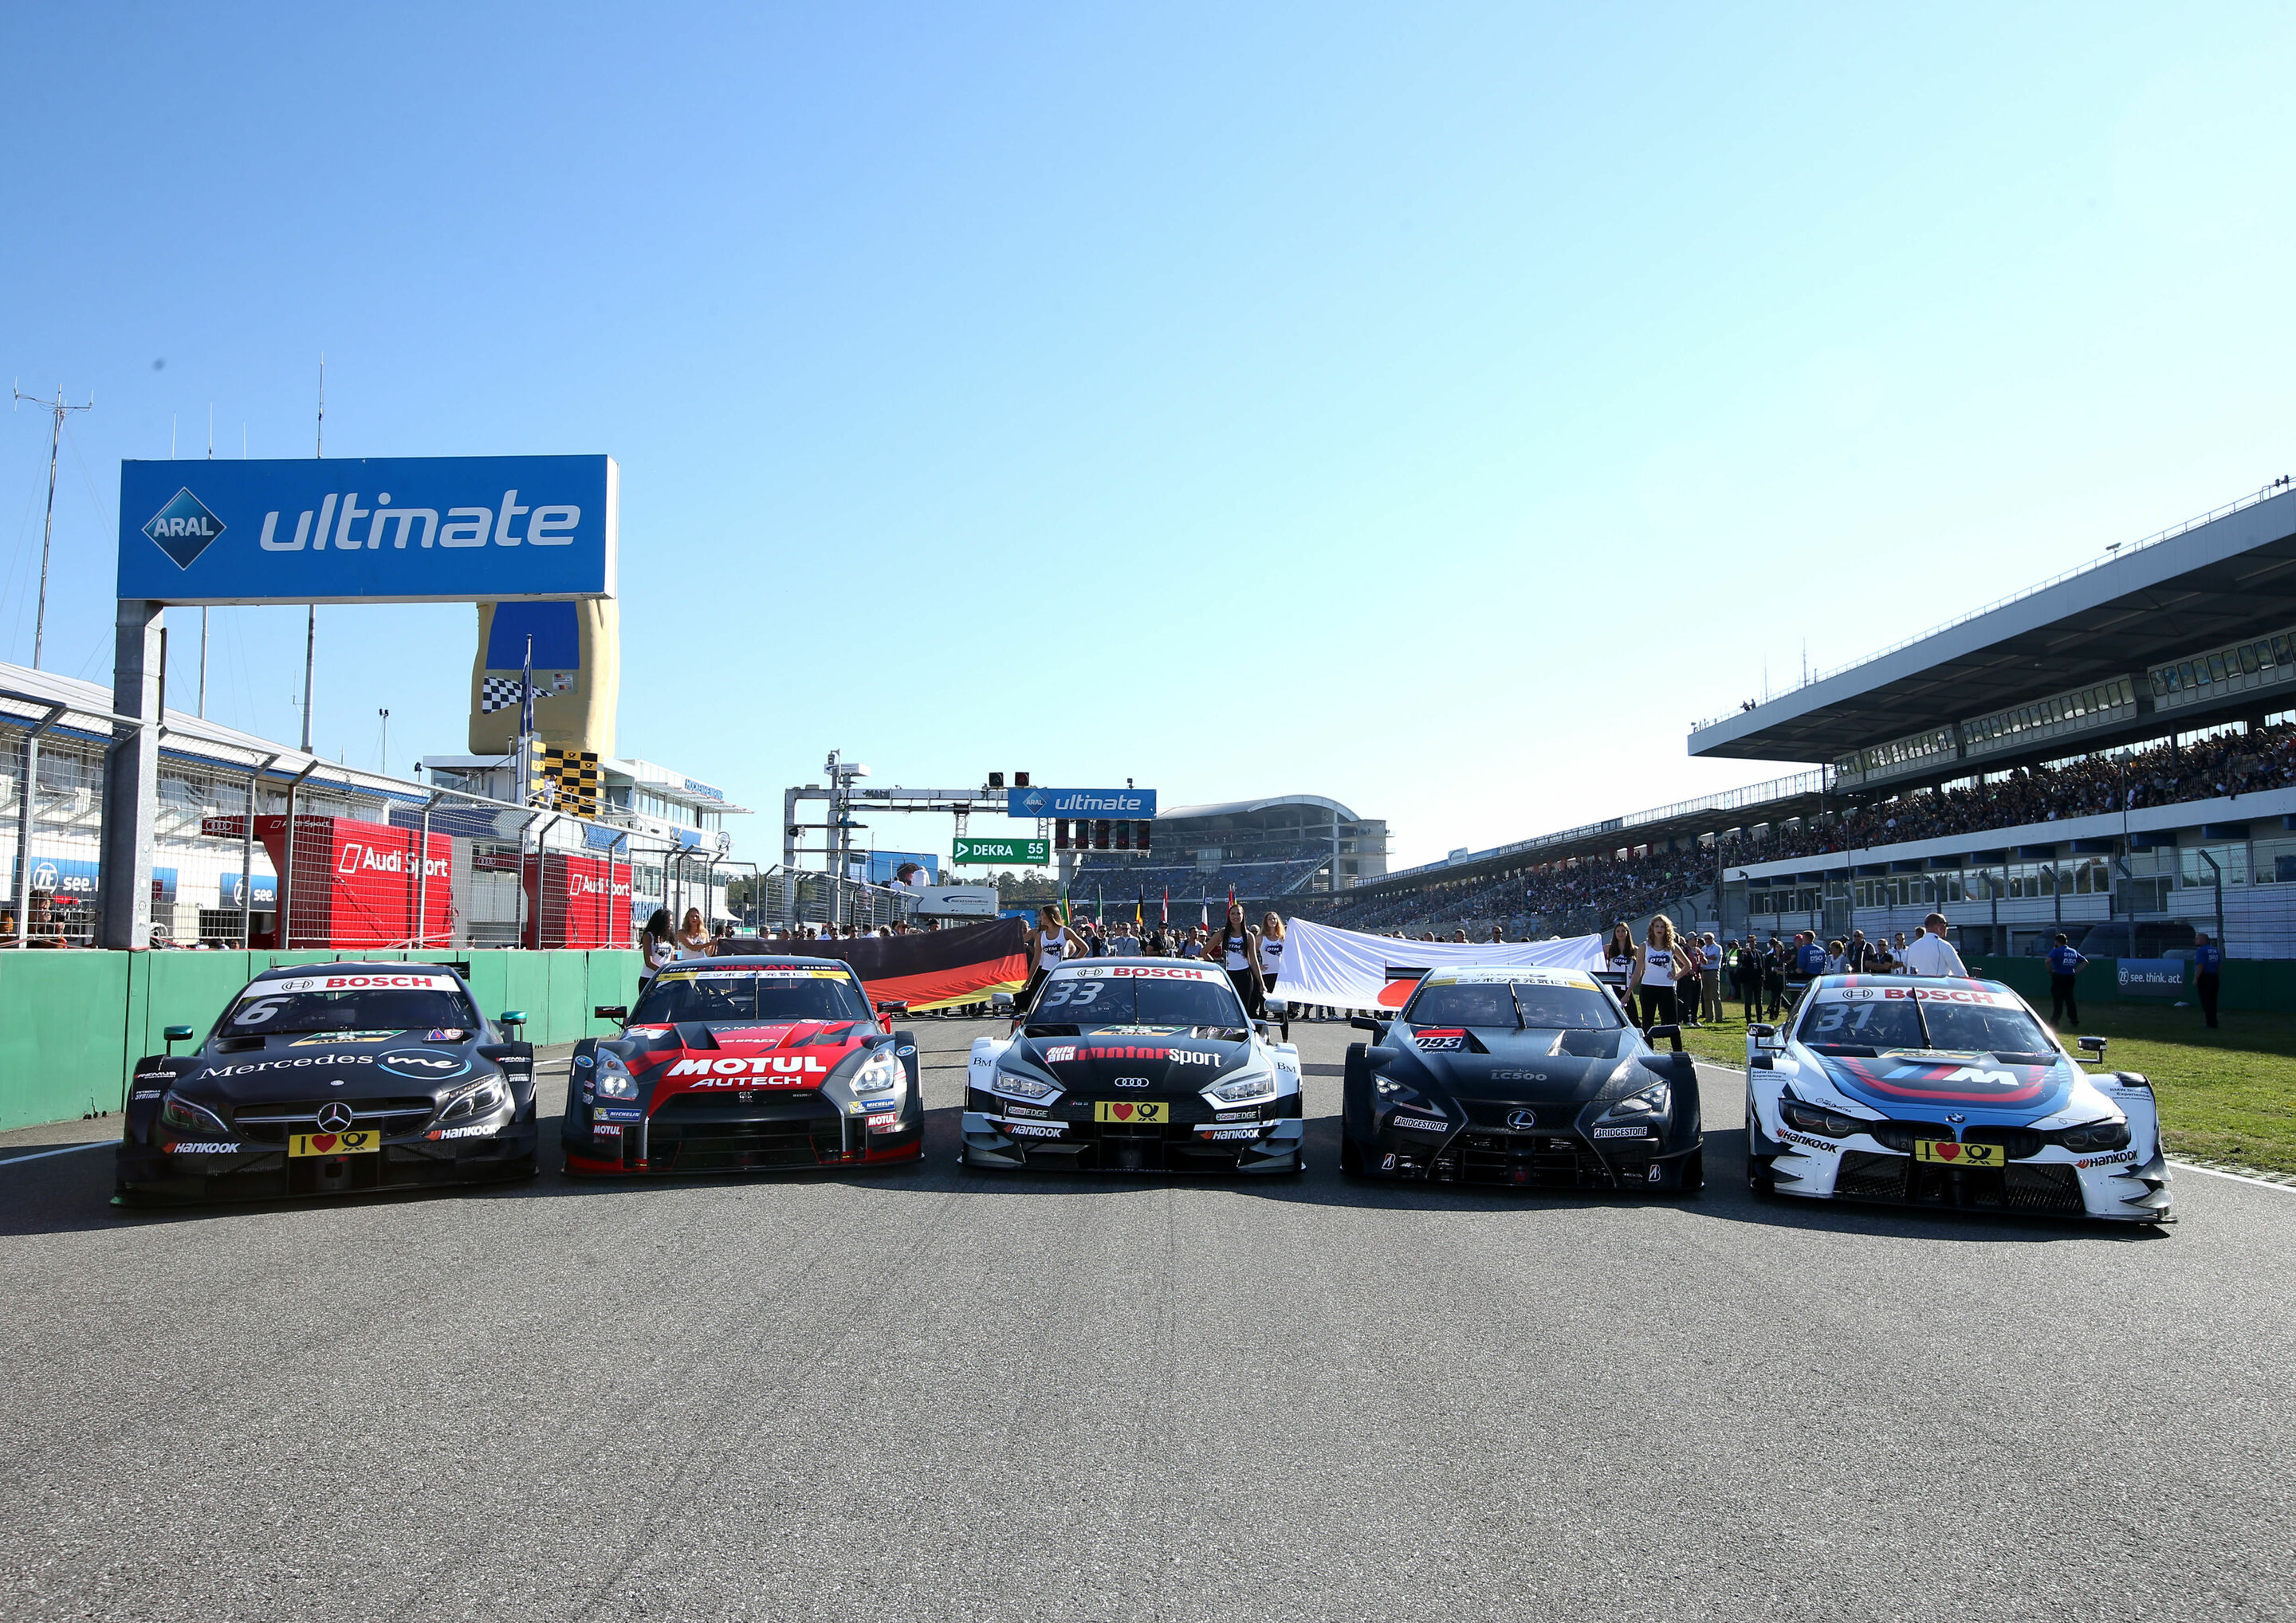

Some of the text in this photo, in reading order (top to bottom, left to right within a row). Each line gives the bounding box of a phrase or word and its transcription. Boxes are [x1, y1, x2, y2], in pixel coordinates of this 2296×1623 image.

[153, 516, 214, 538] ARAL
[259, 489, 581, 552] ultimate
[1055, 794, 1142, 811] ultimate
[973, 844, 1014, 856] DEKRA
[1027, 843, 1044, 855] 55
[363, 846, 401, 873] Audi
[63, 876, 92, 892] see.
[583, 875, 603, 894] Audi
[254, 888, 273, 902] see.
[1113, 967, 1203, 980] BOSCH
[2130, 973, 2145, 983] see.
[2145, 972, 2167, 983] think.
[2168, 974, 2183, 984] act.
[326, 977, 432, 988] BOSCH
[1043, 981, 1105, 1007] 33
[1884, 988, 1995, 1004] BOSCH
[234, 997, 293, 1025] 6
[1814, 1003, 1876, 1032] 31
[1416, 1037, 1461, 1048] 093
[1046, 1046, 1076, 1055] Auto
[196, 1053, 461, 1080] Mercedes me
[666, 1056, 828, 1077] MOTUL
[689, 1075, 802, 1089] AUTECH
[1490, 1072, 1548, 1081] LC500
[1026, 1109, 1048, 1118] EDGE
[1103, 1102, 1109, 1121] I
[867, 1114, 894, 1126] MOTUL
[1394, 1116, 1448, 1131] BRIDGESTONE
[593, 1125, 620, 1135] MOTUL
[1594, 1126, 1647, 1138] BRIDGESTONE
[301, 1135, 306, 1155] I
[1924, 1142, 1930, 1161] I
